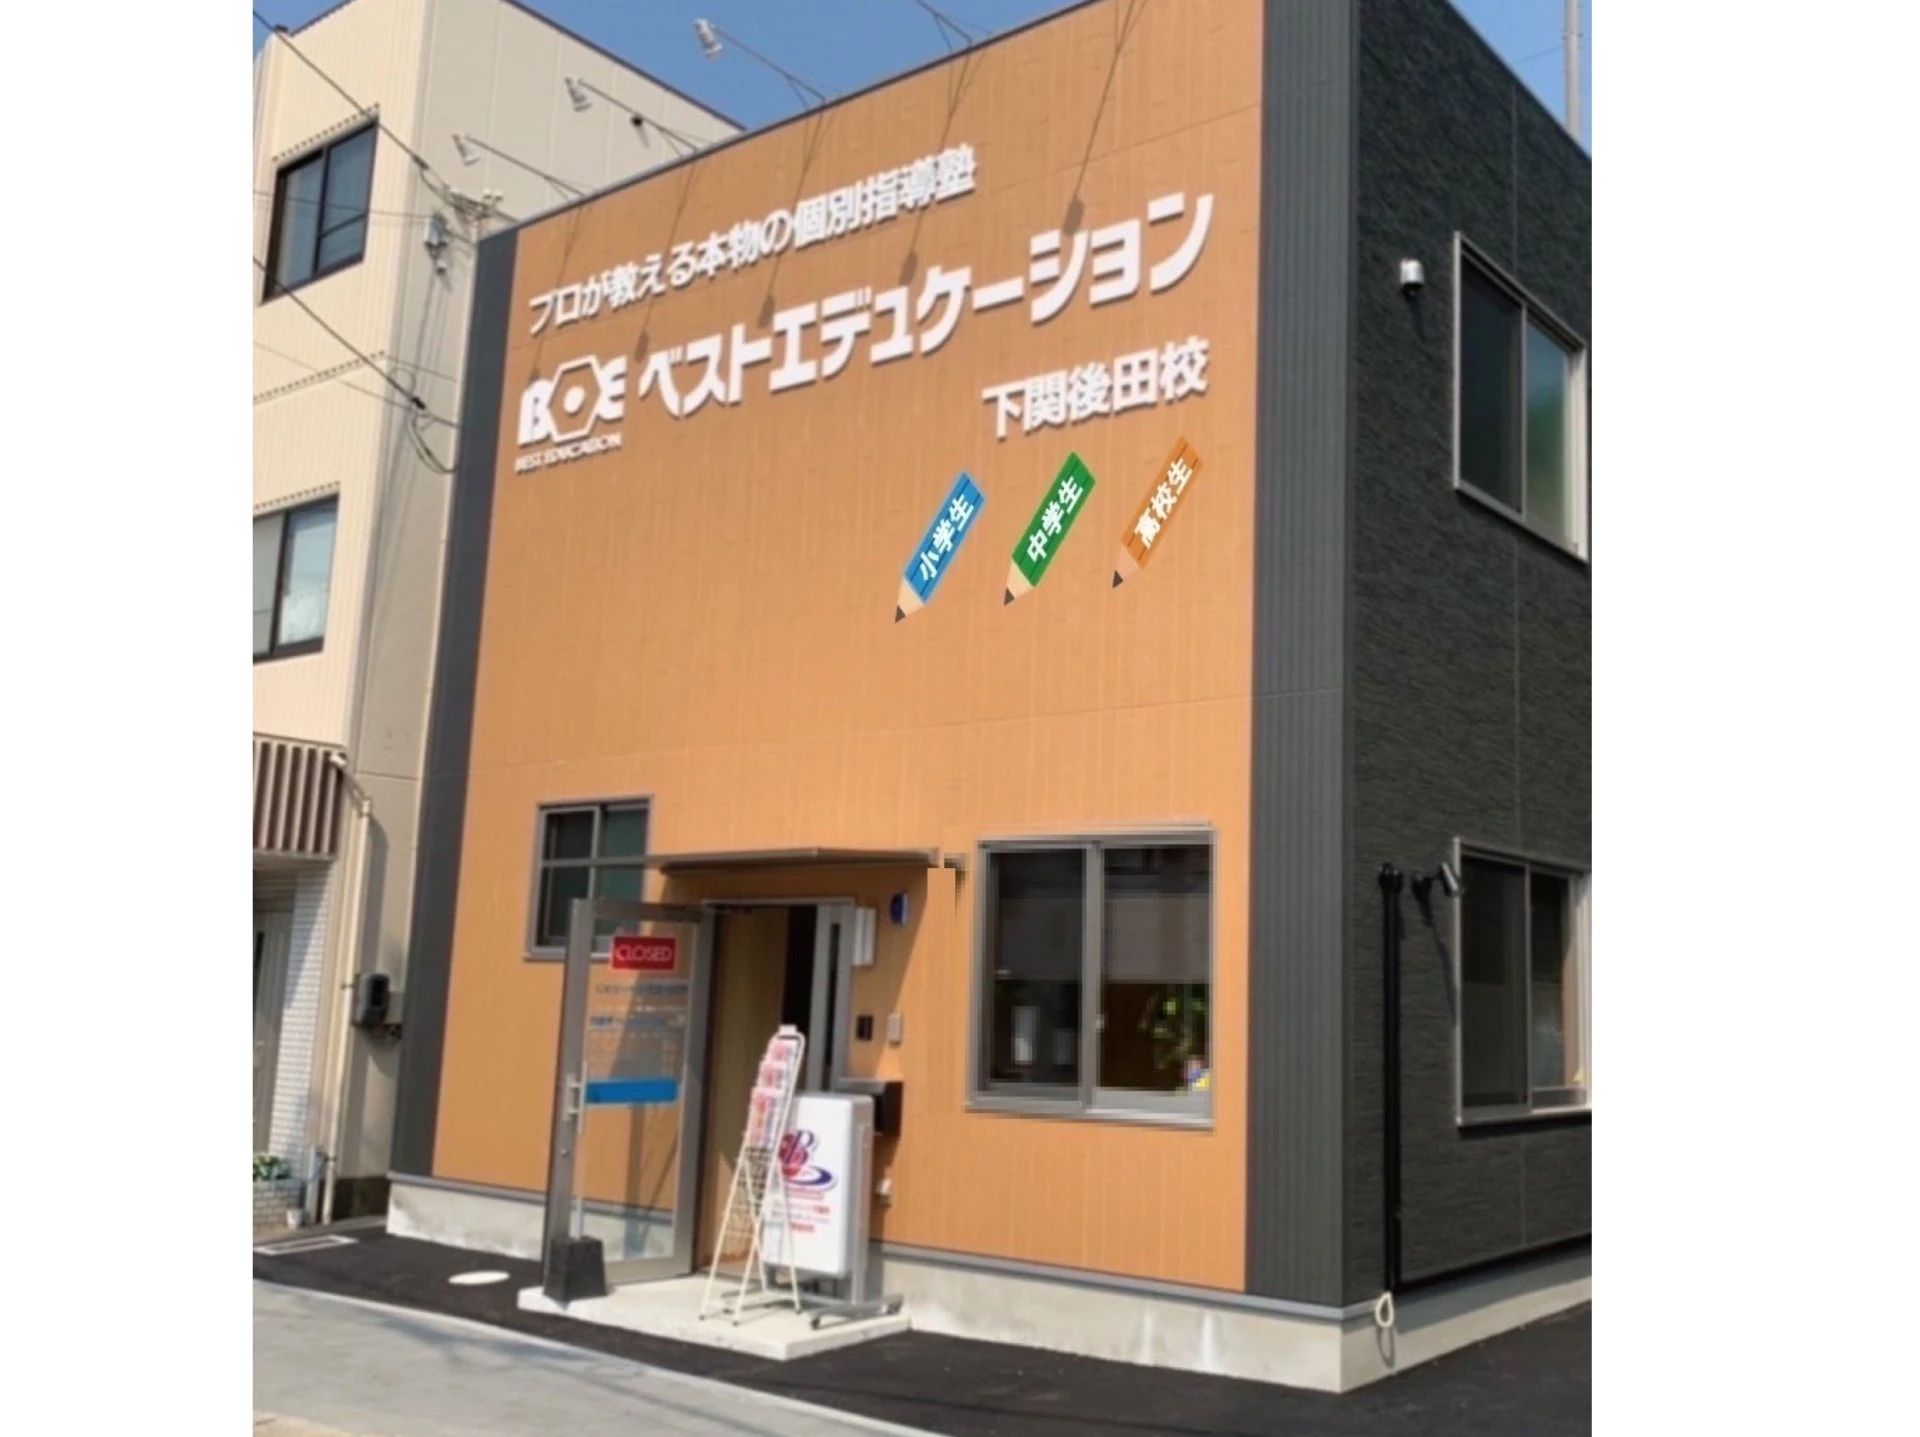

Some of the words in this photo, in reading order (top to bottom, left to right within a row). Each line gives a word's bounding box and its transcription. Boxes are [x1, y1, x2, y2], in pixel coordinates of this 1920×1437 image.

[529, 144, 976, 335] プロが教える本物の個別指導塾
[638, 193, 1214, 416] ベストエデュケーション
[982, 336, 1209, 438] 下関後田校
[919, 495, 974, 581] 小学生
[1027, 476, 1083, 562] 中学生
[1134, 458, 1193, 549] 高校生
[616, 944, 673, 961] CLOSED
